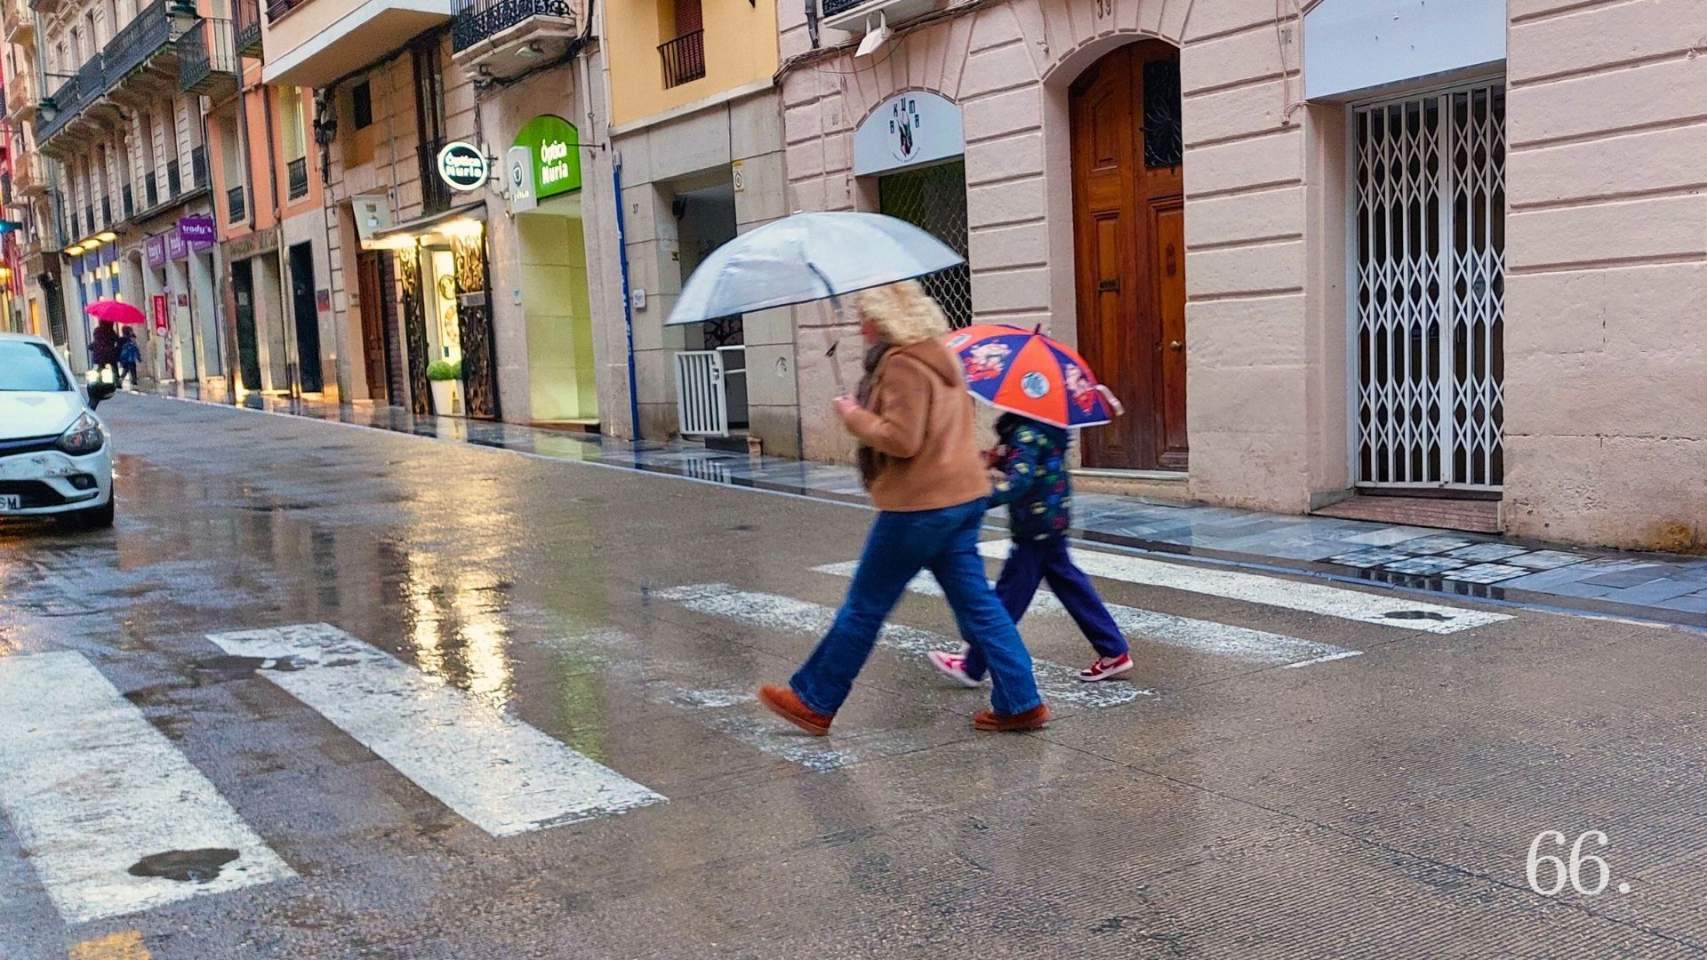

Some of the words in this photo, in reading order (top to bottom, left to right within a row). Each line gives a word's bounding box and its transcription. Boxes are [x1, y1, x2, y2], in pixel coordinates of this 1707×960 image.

[541, 139, 568, 162] Óptica
[446, 165, 482, 178] Nuria
[542, 162, 569, 184] Nuria
